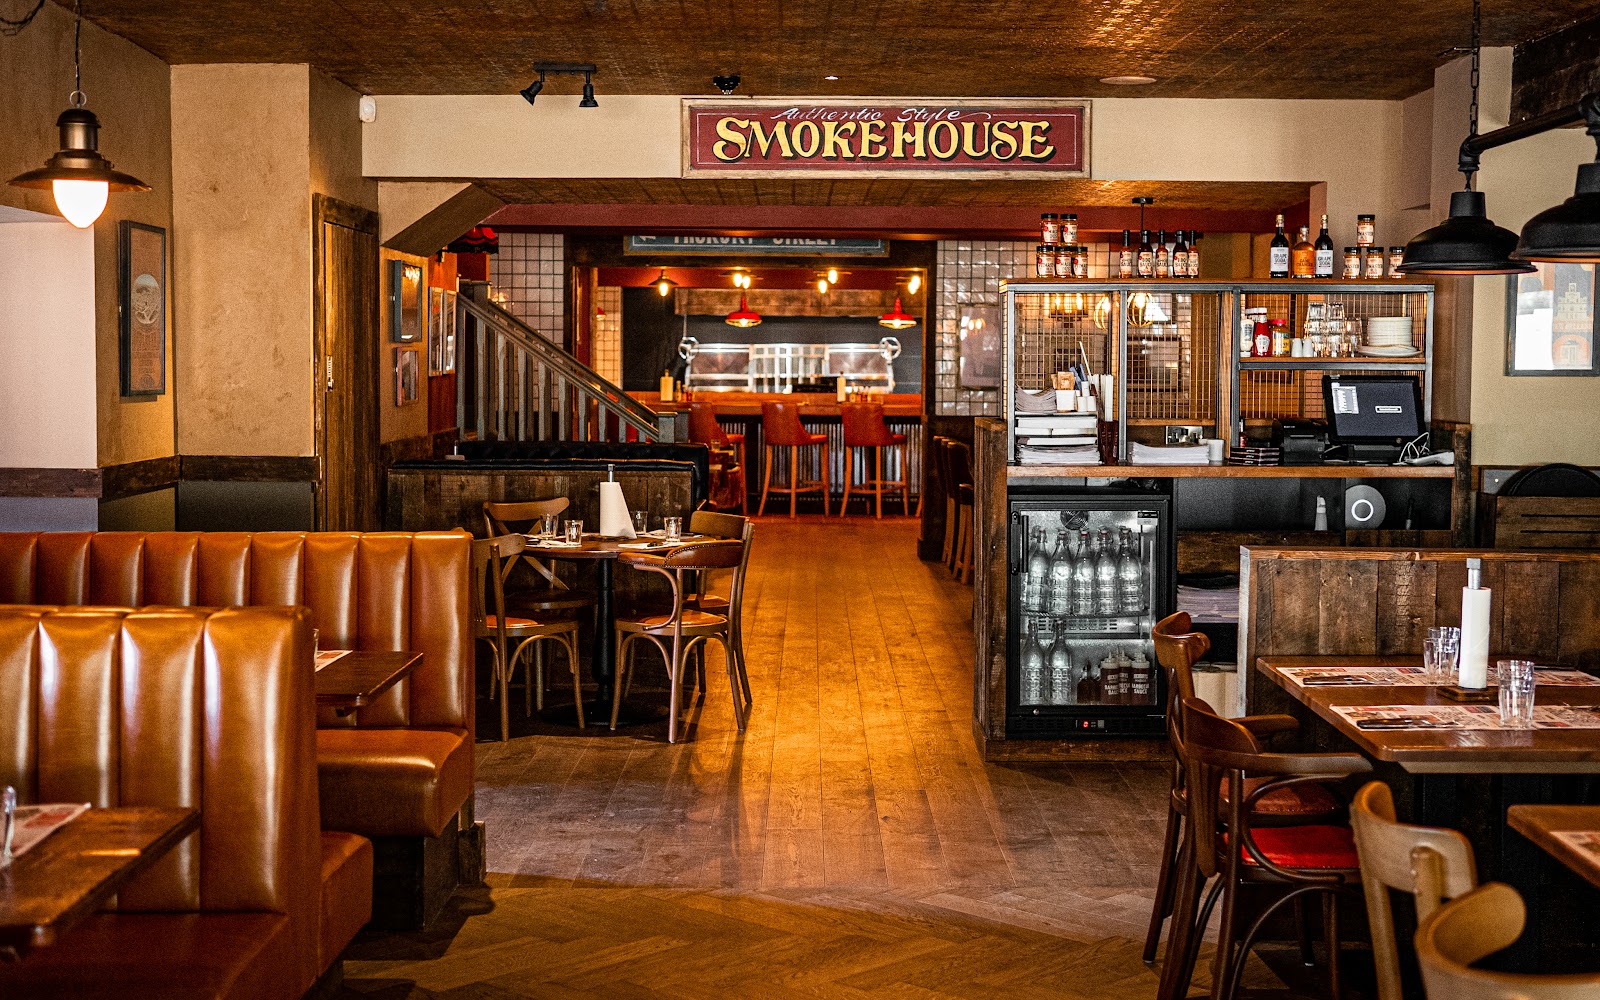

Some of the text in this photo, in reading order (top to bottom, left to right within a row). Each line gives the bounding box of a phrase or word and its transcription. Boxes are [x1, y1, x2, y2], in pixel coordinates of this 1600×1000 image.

[770, 107, 963, 127] Authentic Style
[712, 116, 1055, 162] SMOKEHOUSE
